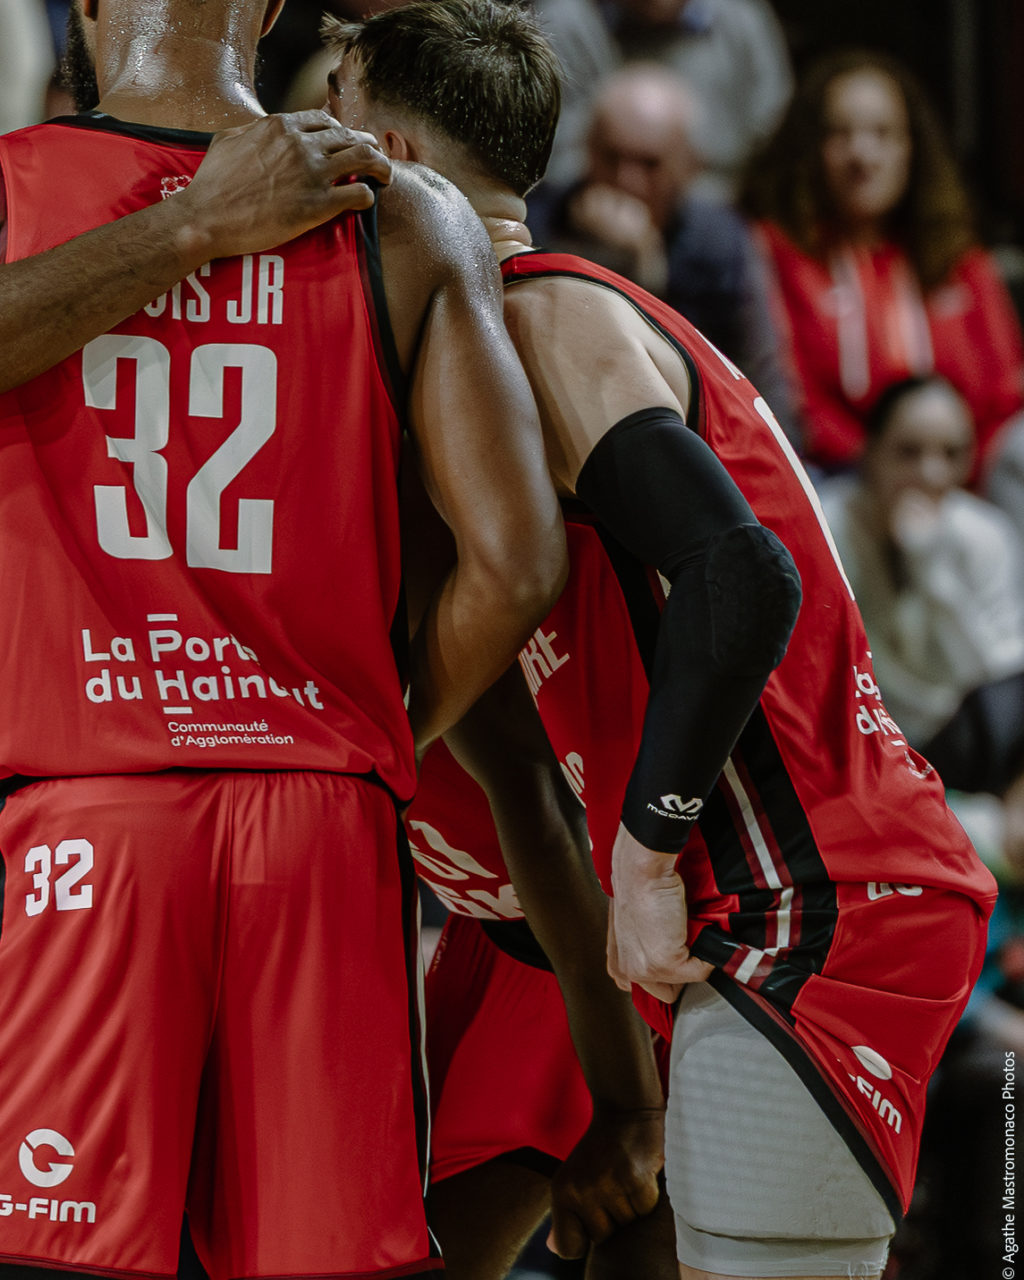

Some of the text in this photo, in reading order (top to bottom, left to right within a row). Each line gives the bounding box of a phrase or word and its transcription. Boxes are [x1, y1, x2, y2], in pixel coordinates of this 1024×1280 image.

[227, 254, 285, 325] JR
[82, 334, 278, 575] 32
[82, 628, 136, 663] La
[85, 669, 143, 704] du
[167, 719, 269, 733] Communauté
[171, 734, 294, 748] d'Agglomération
[24, 838, 94, 917] 32
